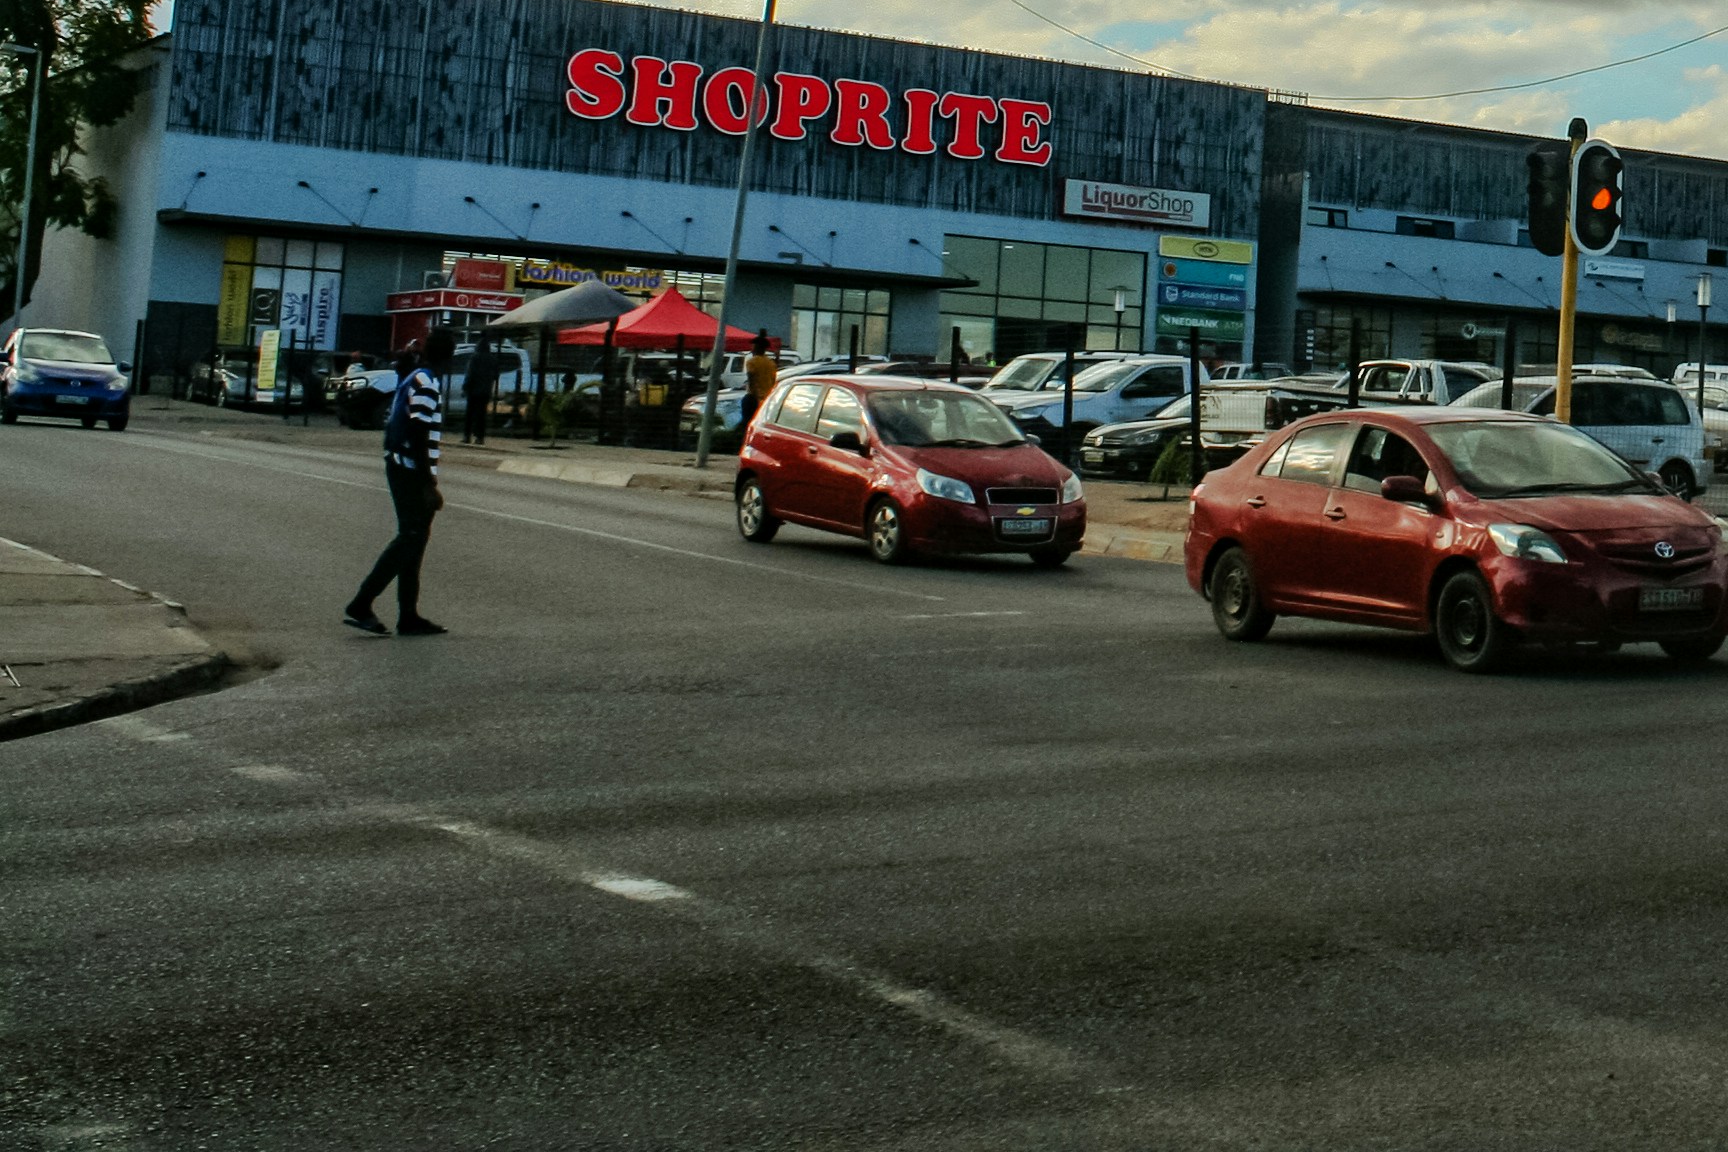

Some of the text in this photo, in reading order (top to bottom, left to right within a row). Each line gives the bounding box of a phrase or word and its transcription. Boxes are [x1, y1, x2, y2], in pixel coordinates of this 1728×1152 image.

[566, 48, 1053, 167] SHOPRITE
[605, 271, 662, 289] world
[1181, 289, 1240, 302] Standard Bank
[1171, 317, 1218, 328] NEDBANK
